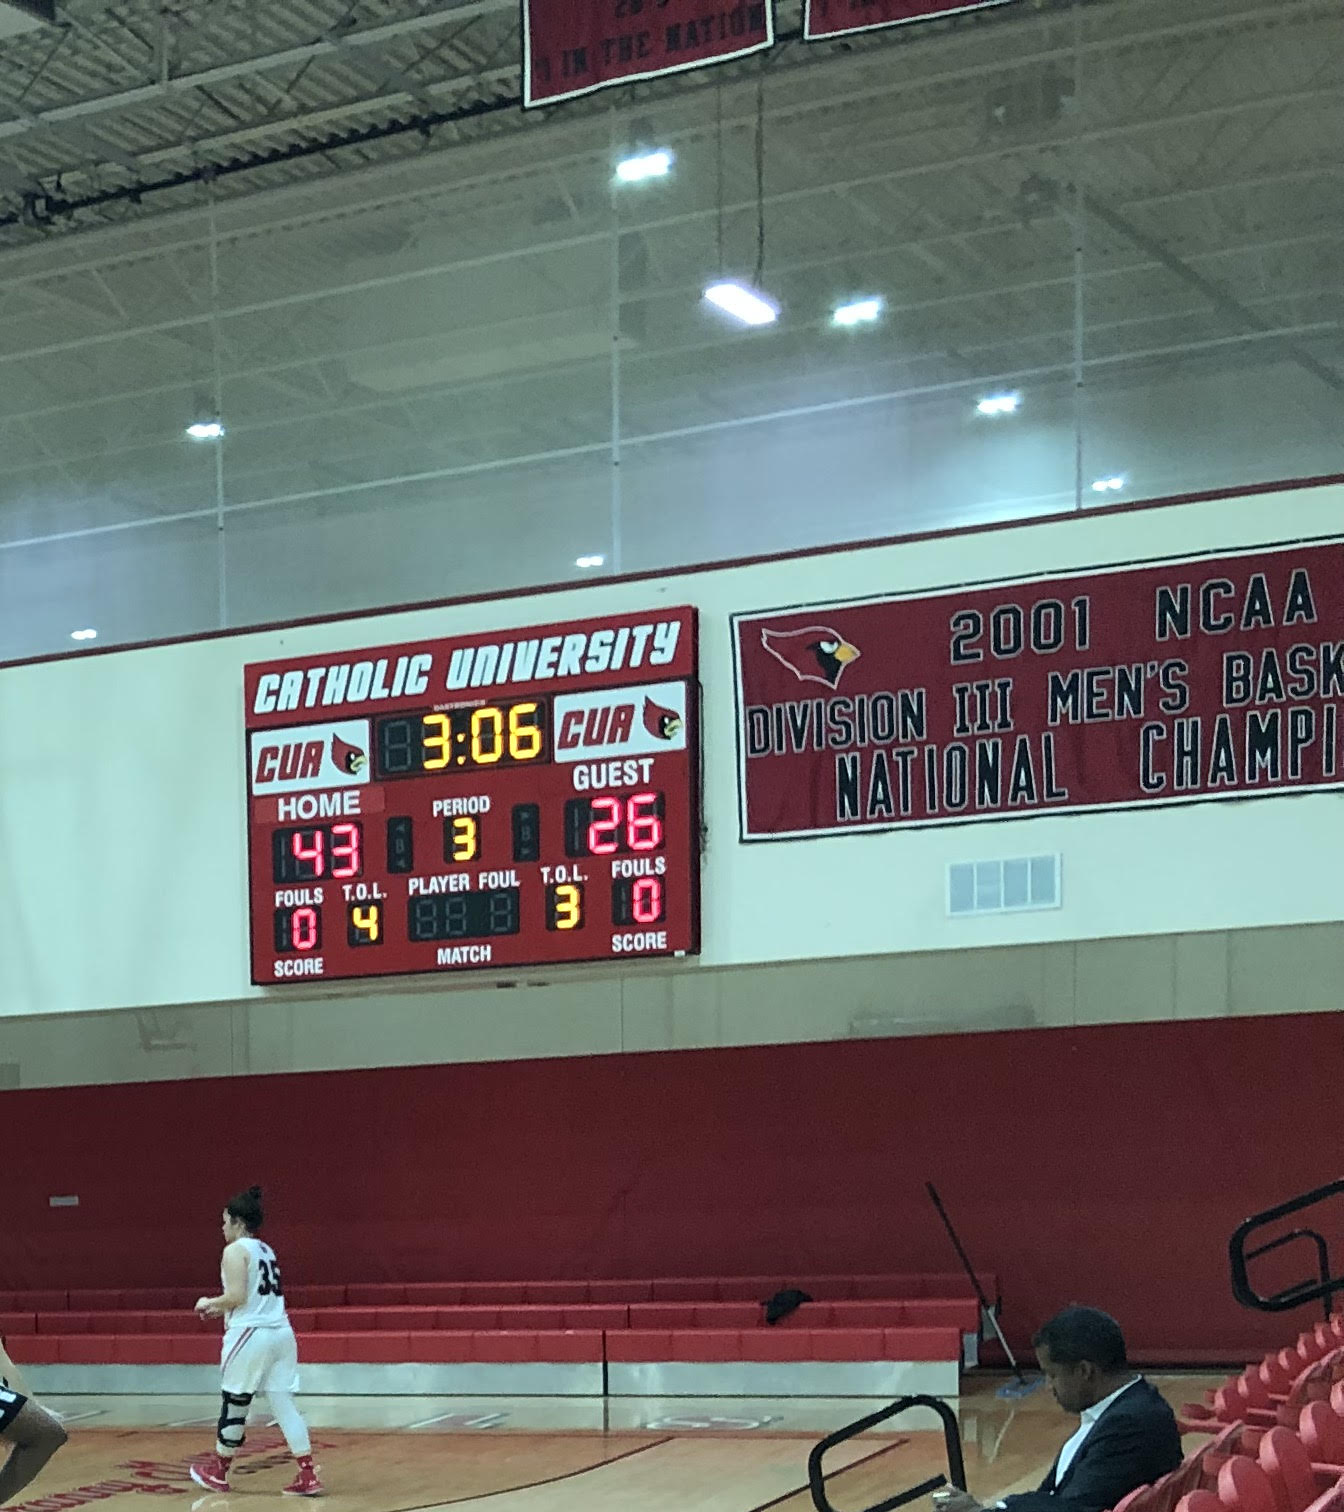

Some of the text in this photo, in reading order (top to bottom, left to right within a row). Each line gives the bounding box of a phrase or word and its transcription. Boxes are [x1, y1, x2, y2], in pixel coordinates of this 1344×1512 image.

[602, 31, 652, 65] THE
[666, 5, 764, 53] NATION
[949, 567, 1319, 665] 2001 NCAA
[254, 620, 682, 715] CATHOLIC UNIVERSITY
[557, 702, 635, 751] CUA
[746, 688, 927, 759] DIVISION
[954, 678, 1014, 737] III
[1048, 659, 1191, 726] MEN'S
[422, 703, 543, 771] 3:06
[255, 739, 325, 784] CUA
[573, 758, 655, 792] GUEST
[835, 730, 1070, 824] NATIONAL
[277, 789, 361, 821] HOME
[432, 795, 491, 818] PERIOD
[588, 792, 663, 855] 26
[292, 823, 360, 879] 43
[452, 818, 477, 862] 3
[408, 869, 520, 897] PLAYER FOUL
[541, 864, 589, 885] T.O.L.
[612, 856, 666, 879] FOULS
[275, 886, 324, 906] FOULS
[343, 883, 388, 903] T.O.L.
[554, 885, 581, 930] 3
[632, 878, 660, 924] 0
[291, 907, 317, 950] 0
[352, 906, 379, 941] 4
[612, 931, 667, 952] SCORE
[274, 957, 324, 977] SCORE
[437, 944, 492, 966] MATCH
[258, 1259, 283, 1297] 35
